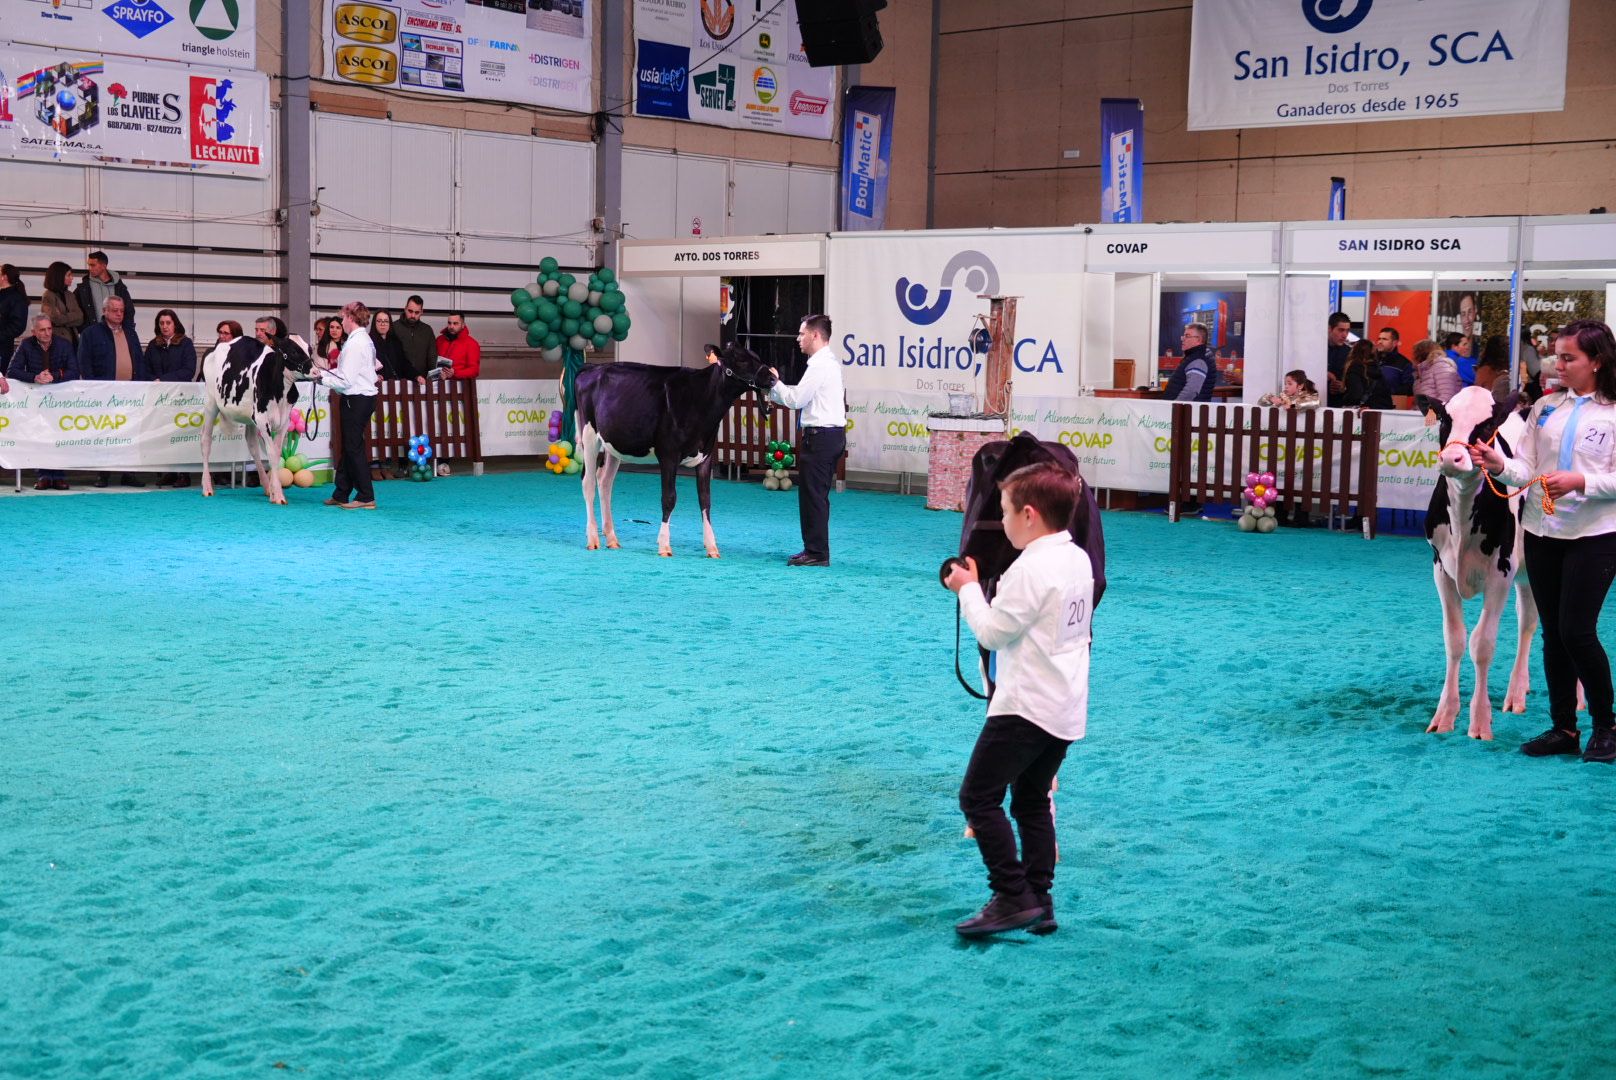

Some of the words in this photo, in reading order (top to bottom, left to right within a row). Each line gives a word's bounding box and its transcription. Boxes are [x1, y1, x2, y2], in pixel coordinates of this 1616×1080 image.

[113, 5, 164, 24] SPRAYFO
[339, 12, 393, 32] ASCOL
[182, 42, 215, 56] triangle
[216, 46, 250, 59] holstein
[1234, 50, 1289, 81] San
[1304, 42, 1410, 77] Isidro,
[1429, 29, 1514, 66] SCA
[340, 55, 394, 73] ASCOL
[1328, 82, 1348, 94] Dos
[1353, 80, 1389, 92] Torres
[132, 91, 160, 105] PURINE
[700, 87, 724, 110] SERVET
[1277, 102, 1356, 118] Ganaderos
[1362, 97, 1406, 113] desde
[1415, 93, 1459, 110] 1965
[107, 106, 118, 116] LOS
[196, 144, 254, 162] LECHAVIT
[855, 130, 873, 210] BouMatic
[1106, 243, 1147, 254] COVAP
[1338, 239, 1368, 251] SAN
[1373, 239, 1425, 251] ISIDRO
[1430, 238, 1461, 250] SCA
[674, 252, 700, 262] AYTO.
[702, 251, 721, 261] DOS
[724, 251, 760, 261] TORRES
[842, 333, 886, 367] San
[899, 335, 982, 377] Isidro,
[1014, 338, 1064, 374] CA
[916, 378, 934, 390] Dos
[0, 395, 29, 409] nimal
[59, 414, 127, 431] COVAP
[507, 409, 546, 424] COVAP
[887, 420, 931, 438] COVA
[1585, 427, 1606, 445] 21
[93, 438, 104, 446] de
[105, 437, 132, 447] futuro
[1057, 430, 1113, 449] COVAP
[1083, 455, 1091, 464] de
[1091, 455, 1116, 465] futuro
[1068, 598, 1085, 626] 20
